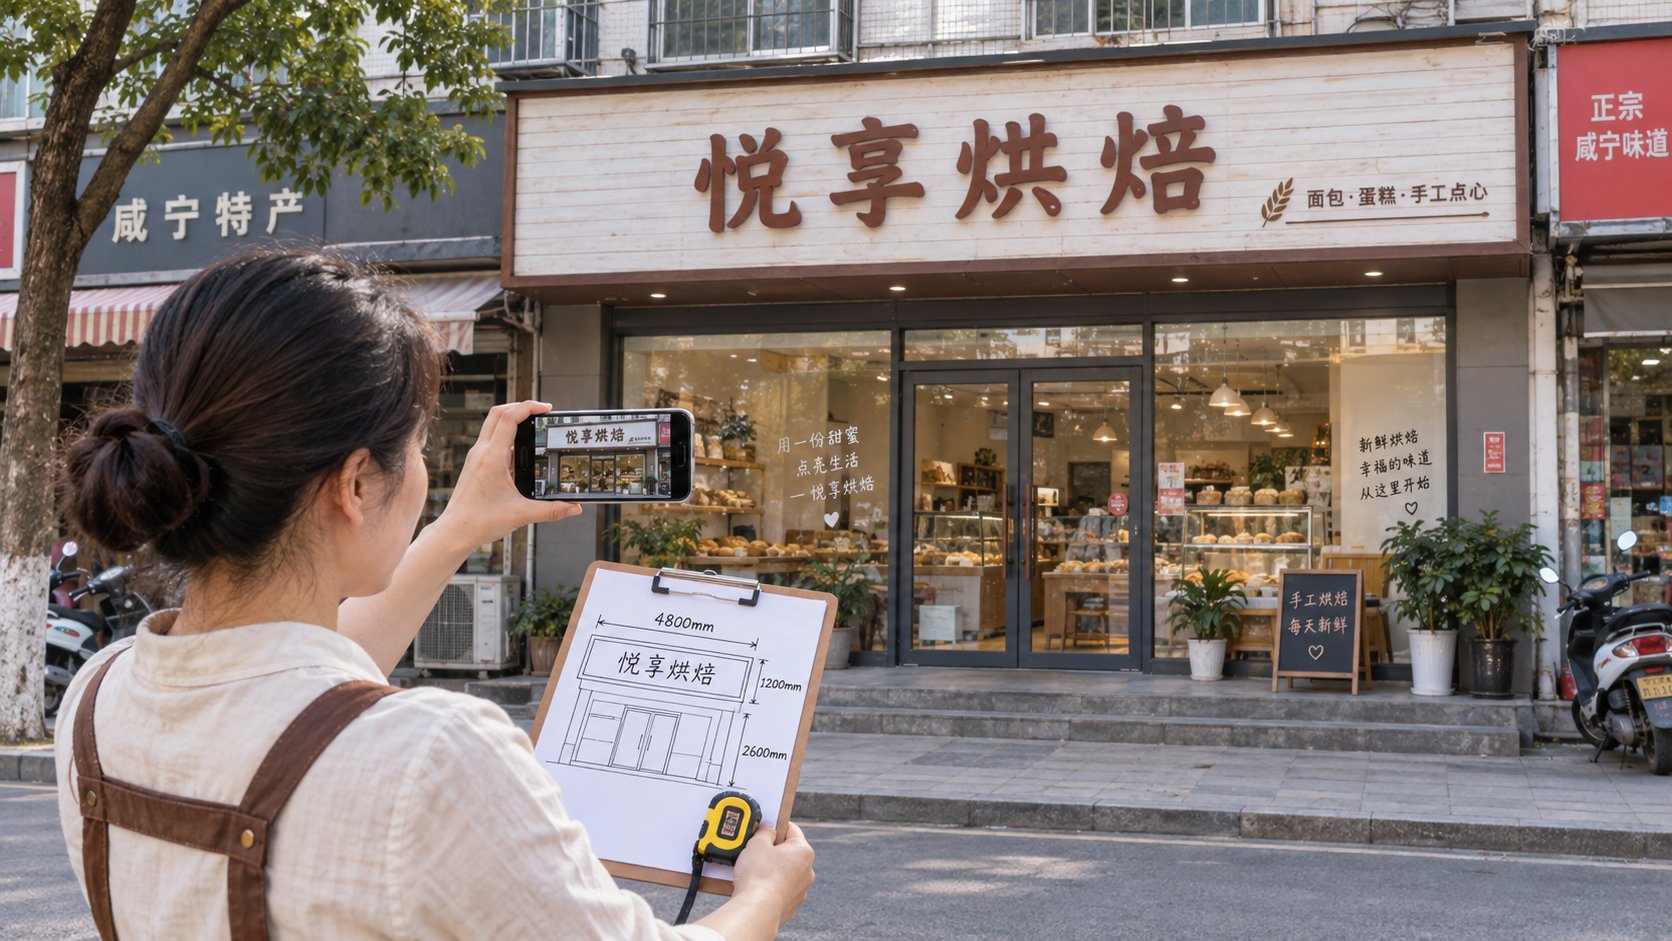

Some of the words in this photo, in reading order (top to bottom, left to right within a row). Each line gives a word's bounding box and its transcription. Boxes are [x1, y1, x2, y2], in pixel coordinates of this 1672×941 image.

[1591, 90, 1644, 122] 正宗
[1575, 128, 1669, 161] 咸宁味道
[694, 104, 1216, 234] 悦享烘焙
[112, 187, 304, 244] 咸宁特产
[565, 427, 625, 444] 悦享烘焙
[777, 425, 859, 454] 用一份甜蜜
[1359, 428, 1419, 453] 新鲜烘焙
[797, 452, 859, 477] 点亮生活
[1360, 449, 1433, 477] 幸福的味道
[1360, 475, 1430, 500] 从这里开始
[1289, 590, 1348, 609] 手工烘焙
[654, 612, 715, 633] 4800mm
[1288, 616, 1348, 636] 每天新鲜
[617, 651, 716, 686] 悦享烘焙
[760, 677, 802, 692] 1200mm
[742, 745, 788, 760] 2600mm
